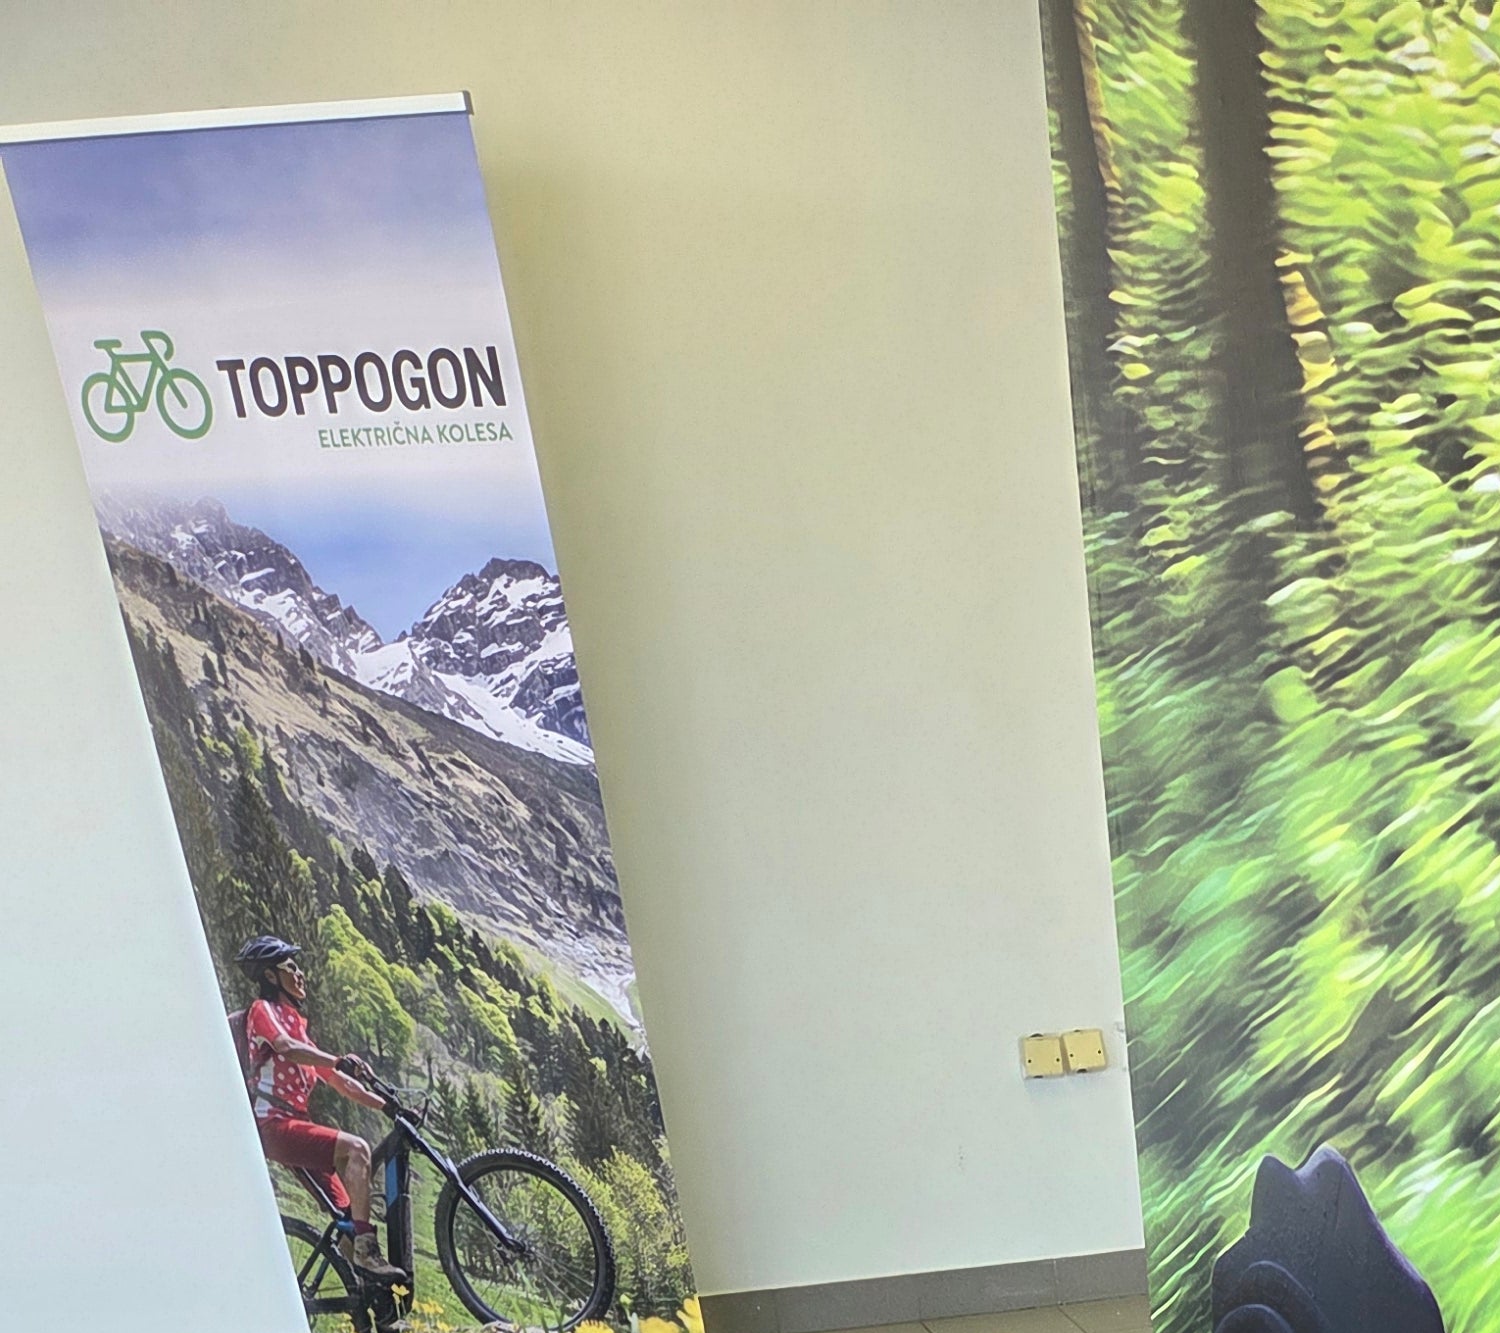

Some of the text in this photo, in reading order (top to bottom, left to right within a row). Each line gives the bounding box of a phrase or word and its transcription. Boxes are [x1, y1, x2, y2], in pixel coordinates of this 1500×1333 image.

[216, 346, 507, 418] TOPPOGON
[318, 421, 513, 448] ELEKTRIČNA KOLESA
